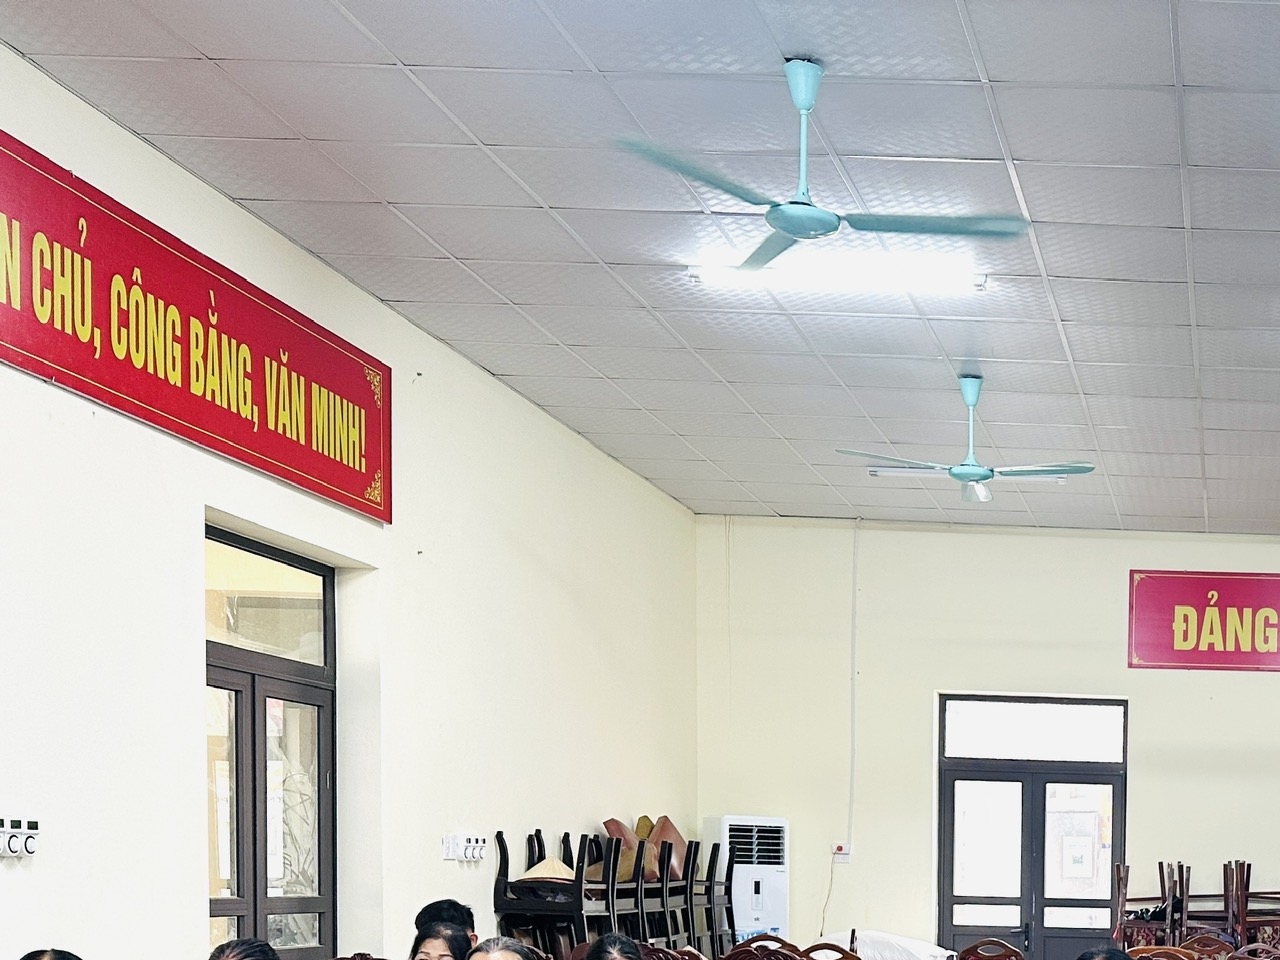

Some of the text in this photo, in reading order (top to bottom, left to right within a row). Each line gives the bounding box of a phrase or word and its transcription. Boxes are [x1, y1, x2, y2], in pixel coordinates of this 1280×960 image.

[32, 217, 101, 360] CHỦ,
[110, 267, 182, 388] CÔNG
[189, 290, 259, 432] BẰNG,
[264, 348, 306, 446] VĂN
[311, 382, 367, 474] MINH!
[1172, 590, 1278, 652] ĐẢNG
